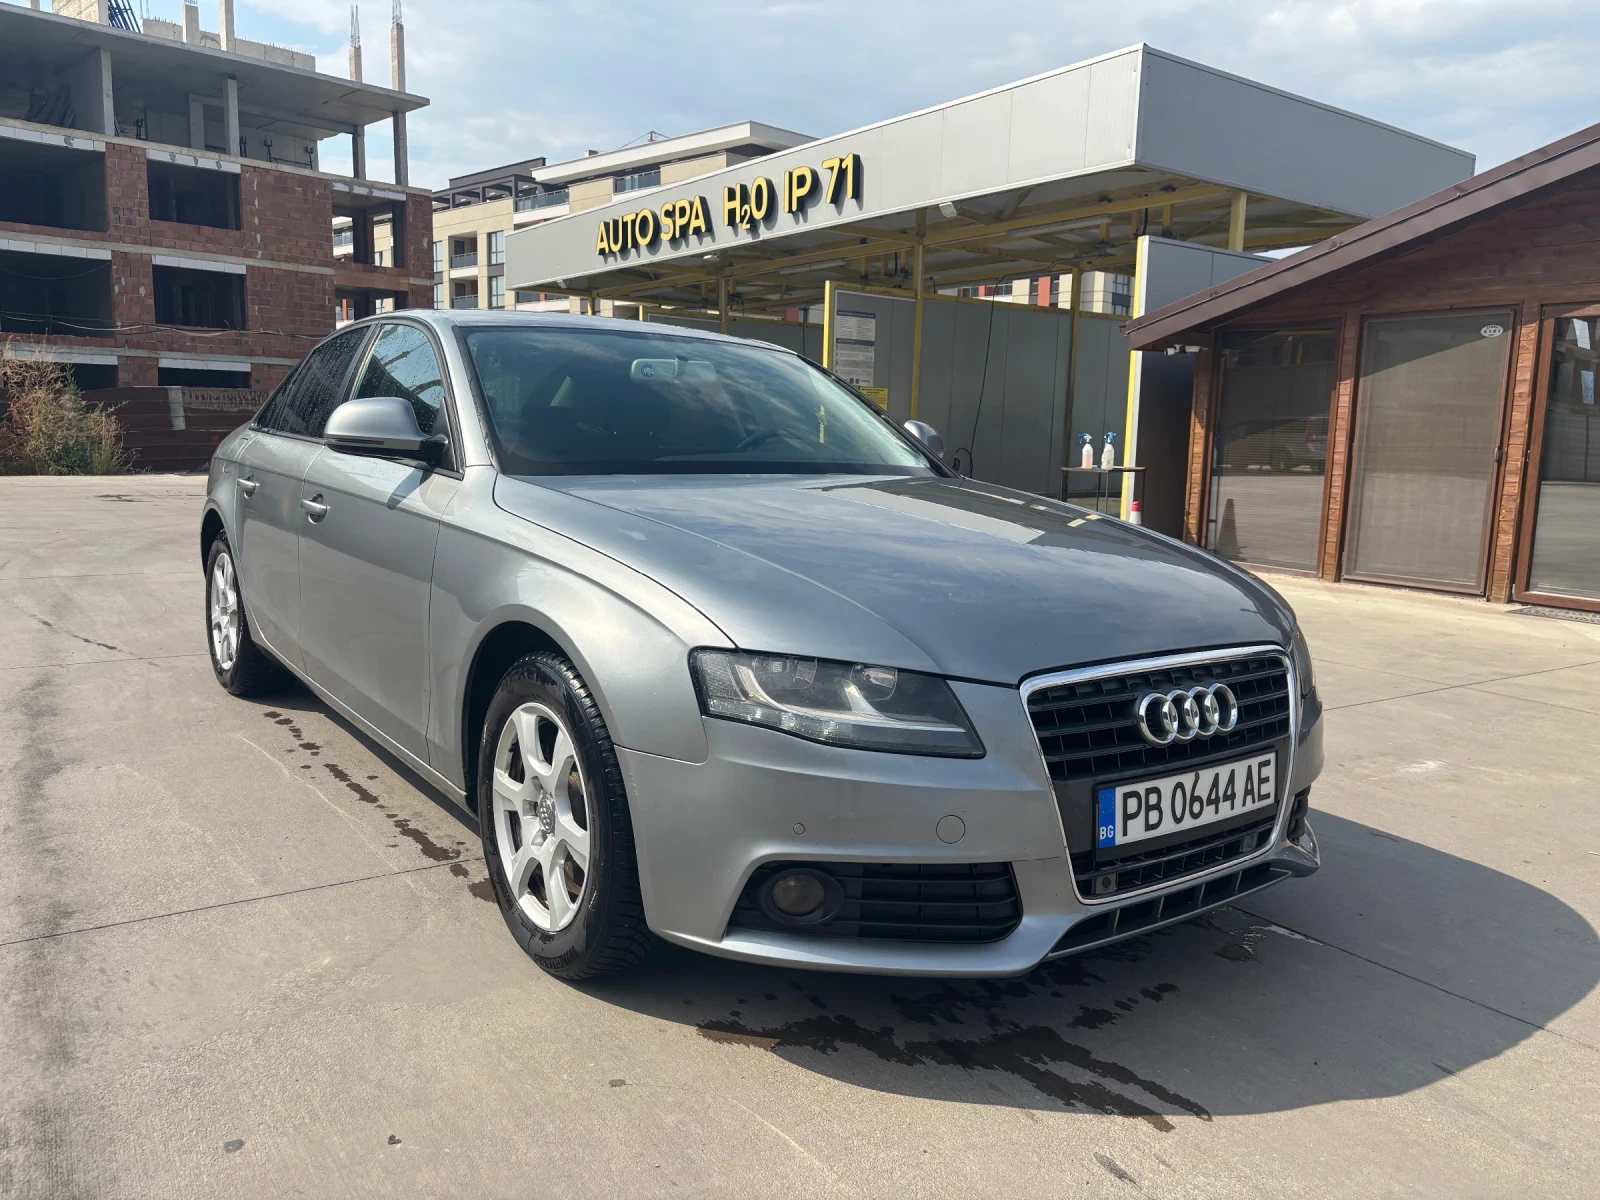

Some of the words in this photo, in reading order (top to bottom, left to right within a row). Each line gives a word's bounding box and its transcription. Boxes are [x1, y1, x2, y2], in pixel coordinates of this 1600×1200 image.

[596, 208, 654, 255] AUTO
[660, 194, 706, 241] SPA
[783, 166, 813, 213] IP
[822, 152, 855, 204] 71
[1171, 768, 1236, 825] 0644
[1100, 825, 1114, 840] BG
